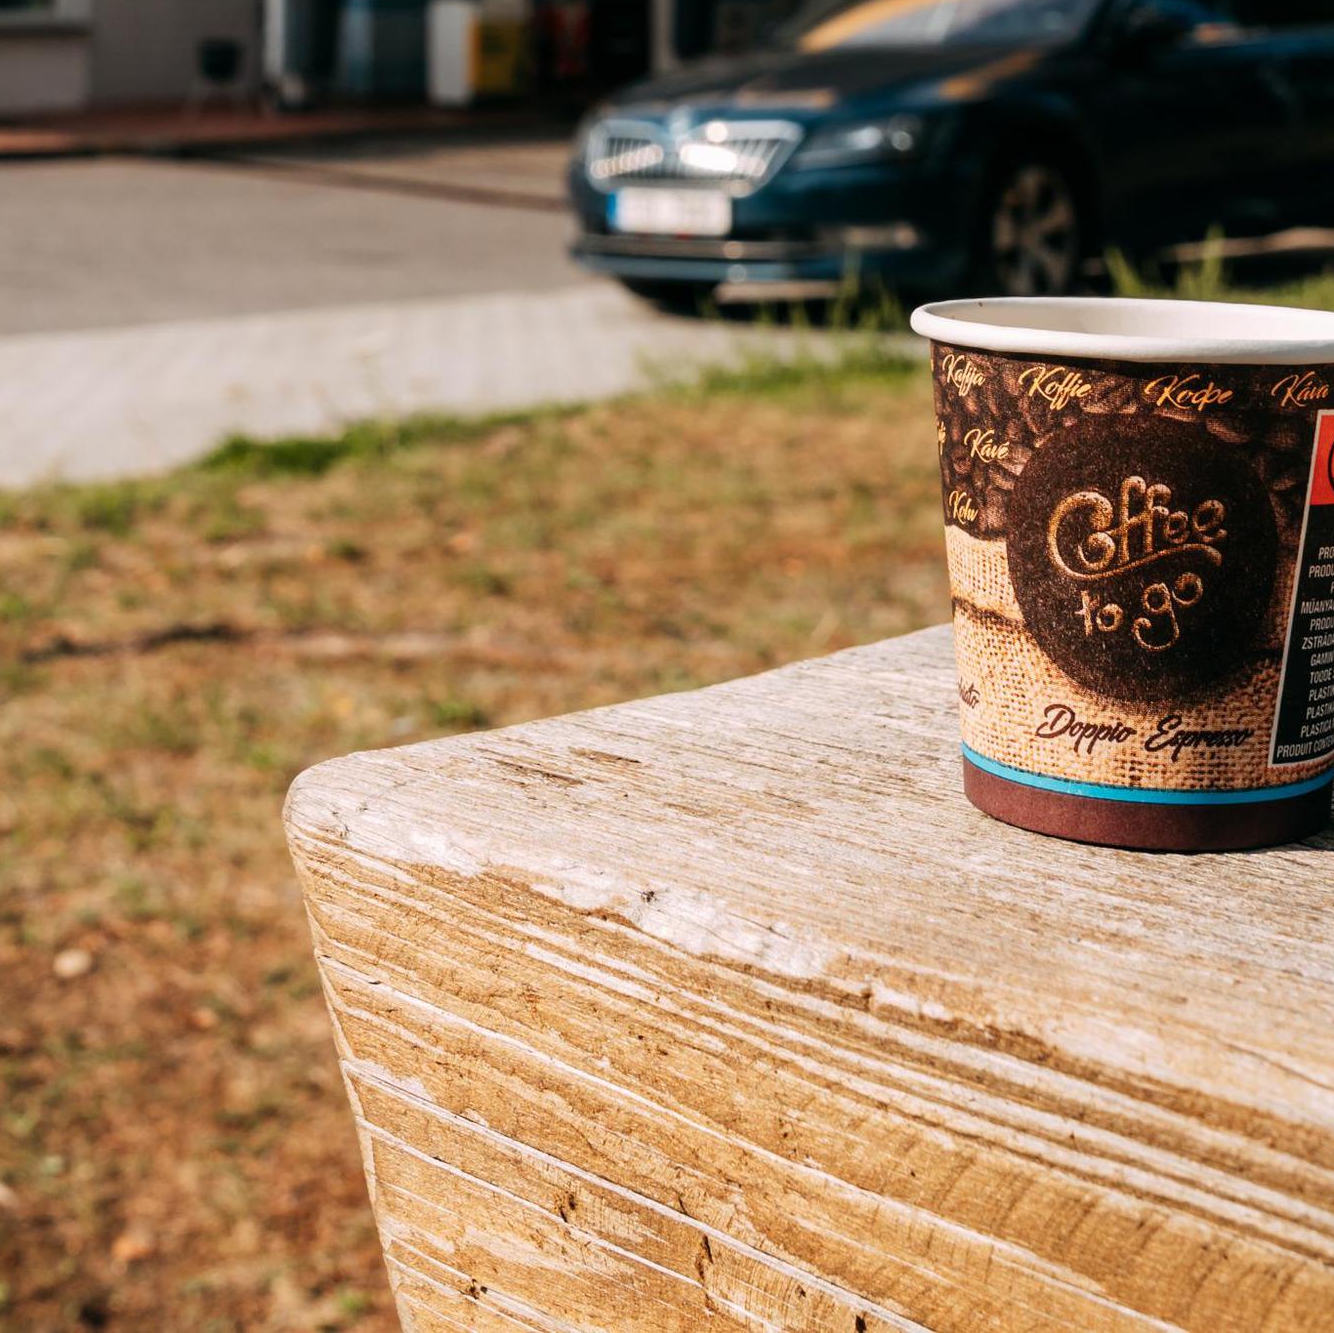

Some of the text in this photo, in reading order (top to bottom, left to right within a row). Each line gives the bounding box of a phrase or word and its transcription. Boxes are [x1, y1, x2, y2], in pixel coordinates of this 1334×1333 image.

[1018, 366, 1092, 411] Koffie
[1047, 475, 1228, 581] Coffee
[1074, 572, 1203, 651] to go
[1035, 703, 1254, 763] Doppio Espresso
[1276, 741, 1312, 758] PRODUIT
